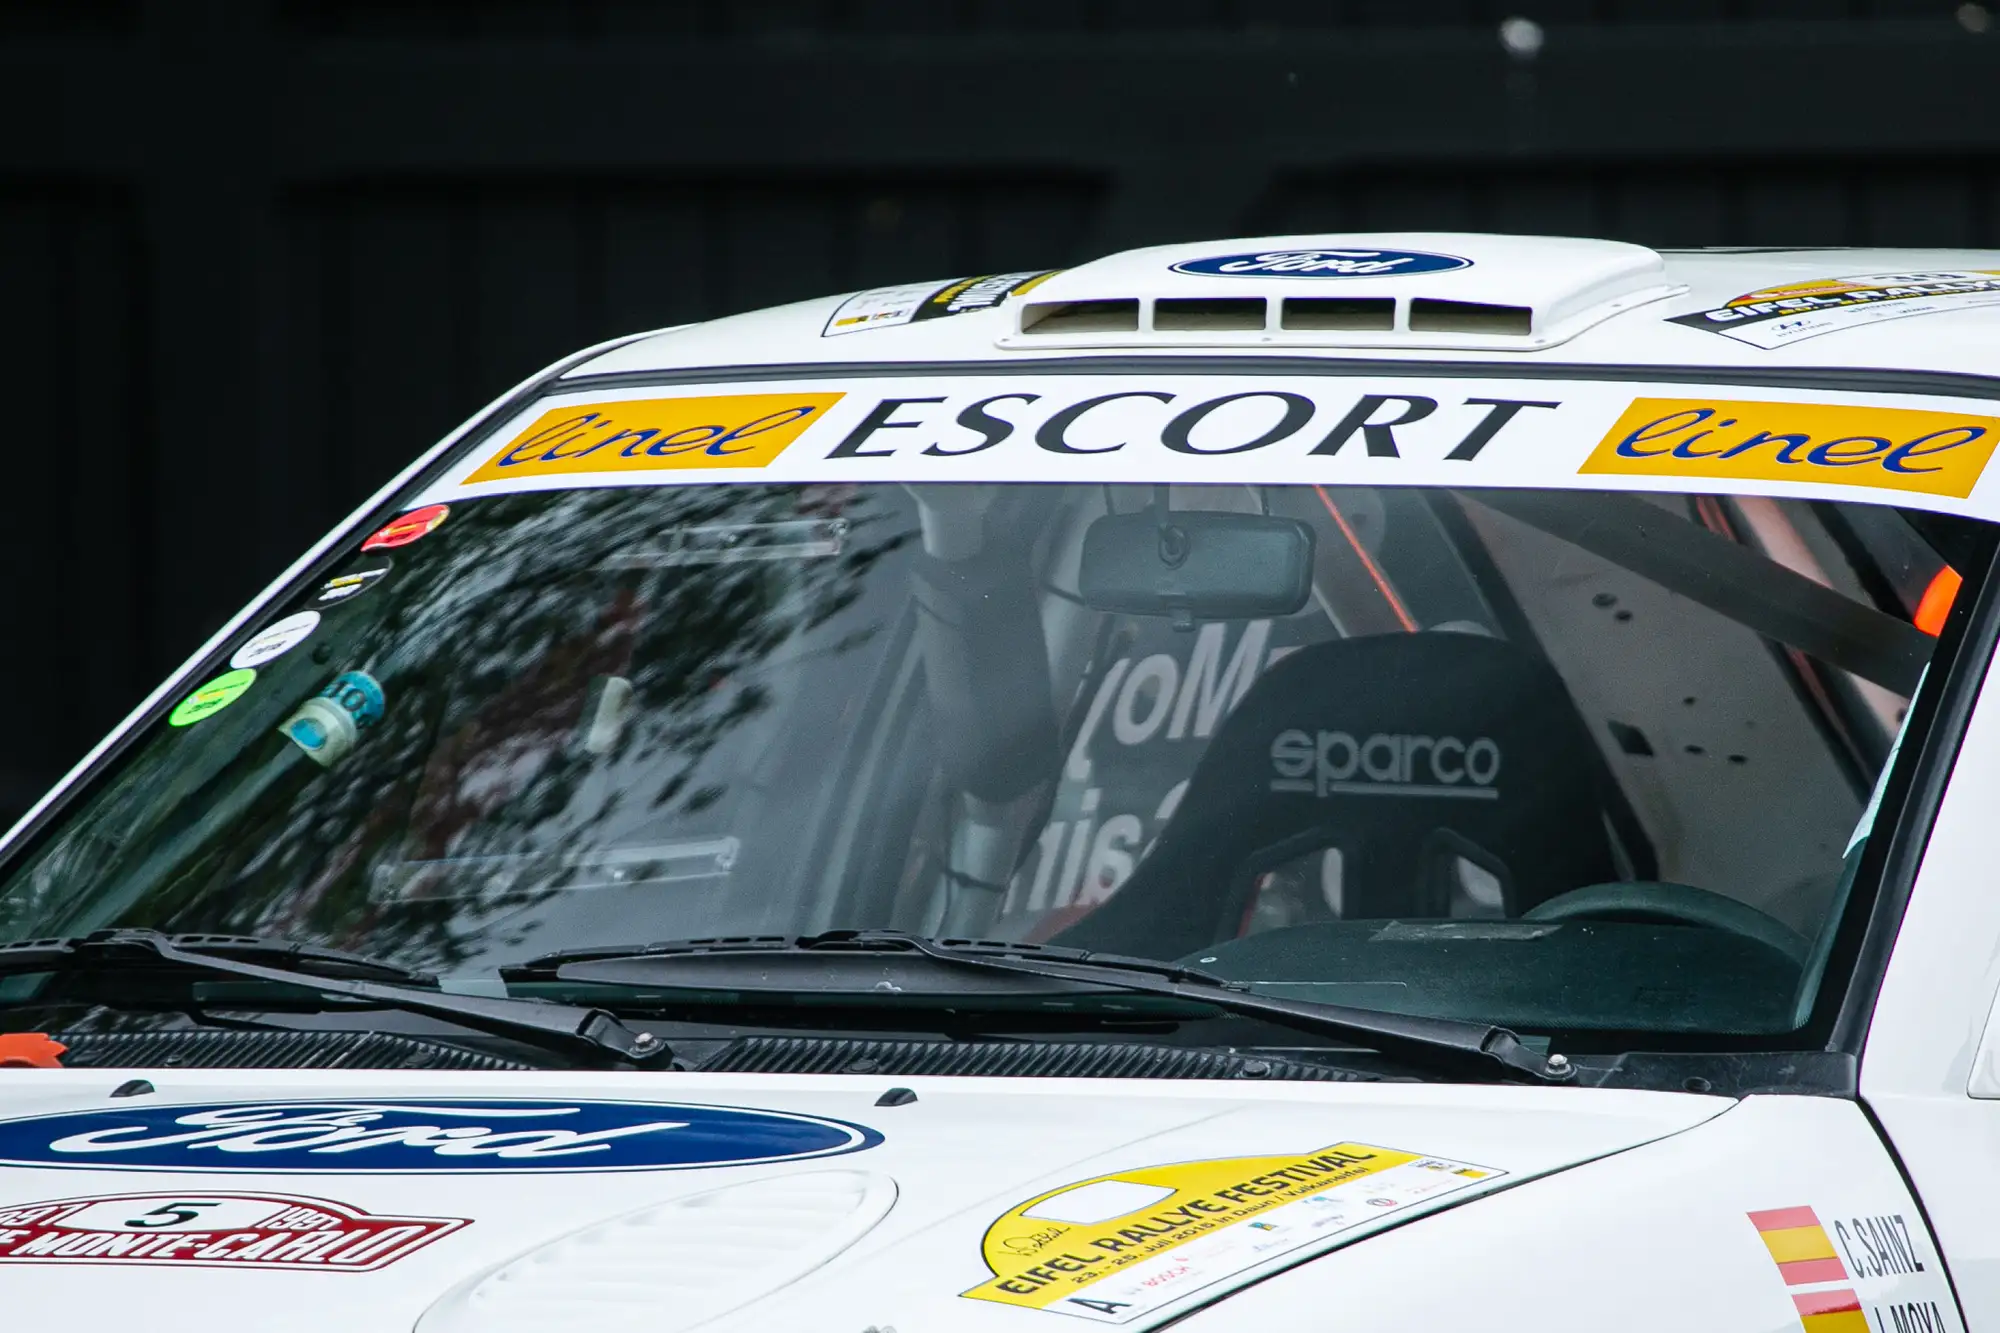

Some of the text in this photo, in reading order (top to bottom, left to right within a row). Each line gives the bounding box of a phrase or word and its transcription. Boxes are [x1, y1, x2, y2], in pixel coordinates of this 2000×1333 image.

[1219, 251, 1415, 273] Ford
[1705, 295, 1842, 322] EIFEL
[497, 405, 817, 468] linel
[824, 391, 1563, 462] ESCORT
[1615, 407, 1988, 475] linel
[1270, 728, 1500, 798] sparco
[49, 1105, 691, 1158] Ford
[124, 1202, 223, 1228] 5
[996, 1253, 1106, 1295] EIFEL
[1088, 1199, 1231, 1253] RALLYE
[1213, 1150, 1379, 1204] FESTIVAL
[1144, 1239, 1174, 1253] Juli
[1212, 1215, 1235, 1224] in
[1231, 1199, 1277, 1217] Daun
[8, 1225, 428, 1263] MONTE-CARLO
[1834, 1214, 1924, 1279] C.SAINZ
[1067, 1297, 1133, 1315] A
